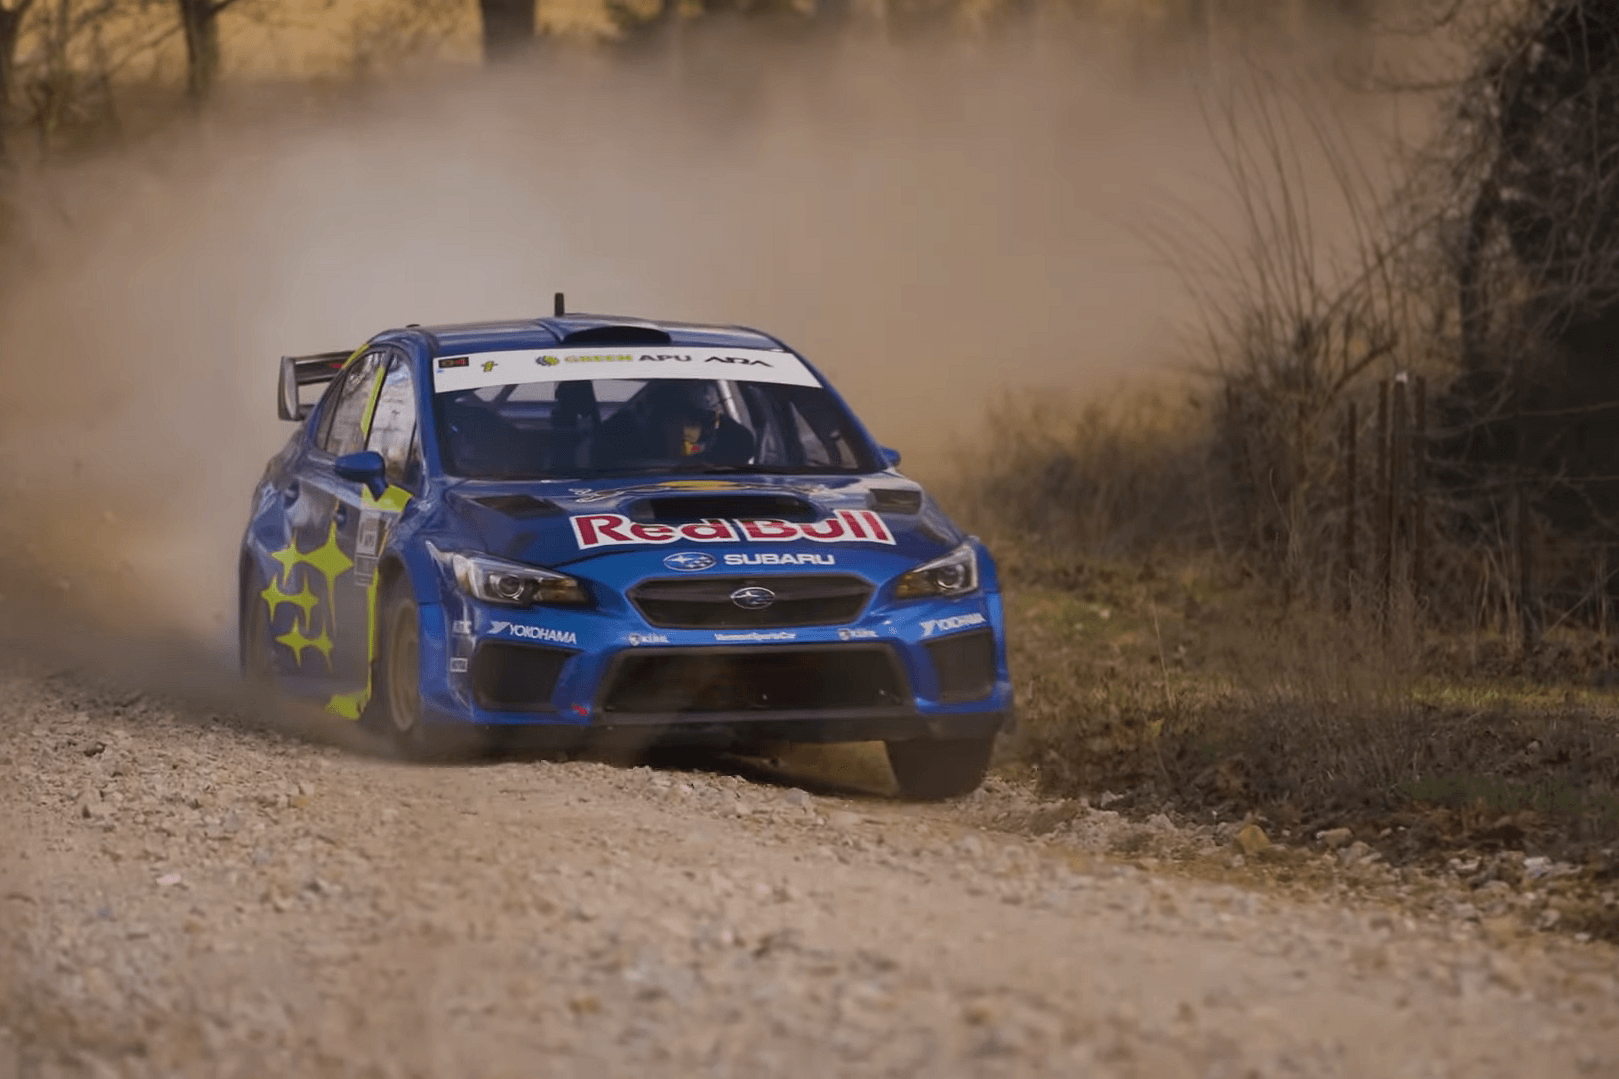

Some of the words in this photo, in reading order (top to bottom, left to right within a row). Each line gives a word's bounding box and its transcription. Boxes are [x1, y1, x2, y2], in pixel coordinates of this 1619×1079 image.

[639, 354, 692, 362] APU
[571, 514, 738, 549] Red
[736, 510, 895, 544] Bull
[724, 553, 835, 566] SUBARU
[509, 624, 577, 644] YOKOHAMA
